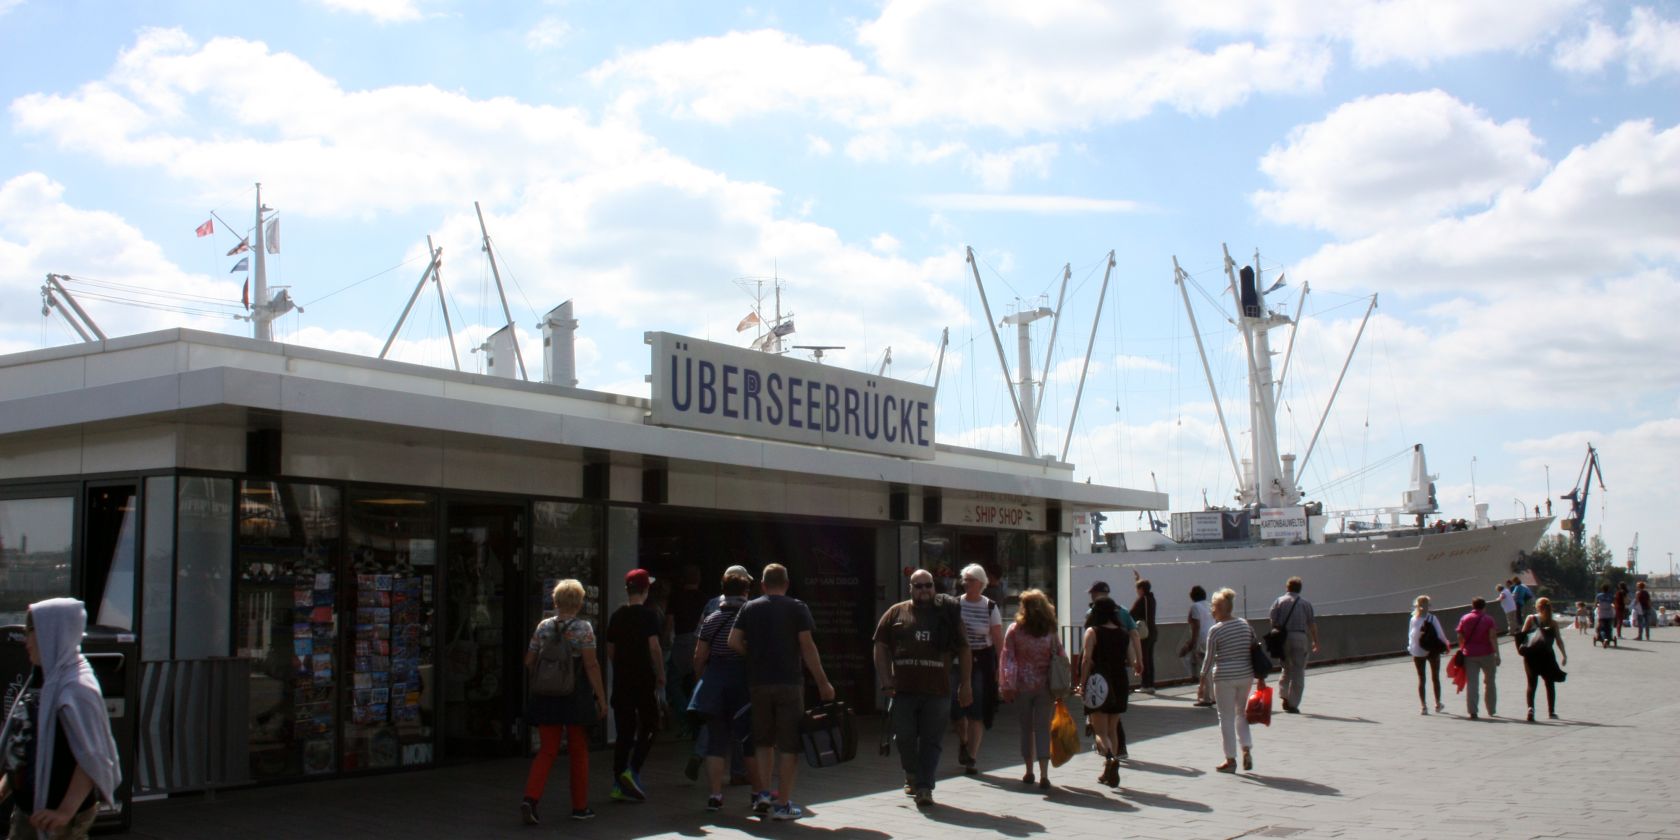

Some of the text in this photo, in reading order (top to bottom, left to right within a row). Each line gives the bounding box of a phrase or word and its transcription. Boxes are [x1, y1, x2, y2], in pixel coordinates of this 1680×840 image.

[671, 342, 930, 447] ÜBERSEEBRÜCKE
[976, 505, 1024, 526] SHIP SHOP
[1261, 518, 1305, 529] KARTONBAUWELTEN
